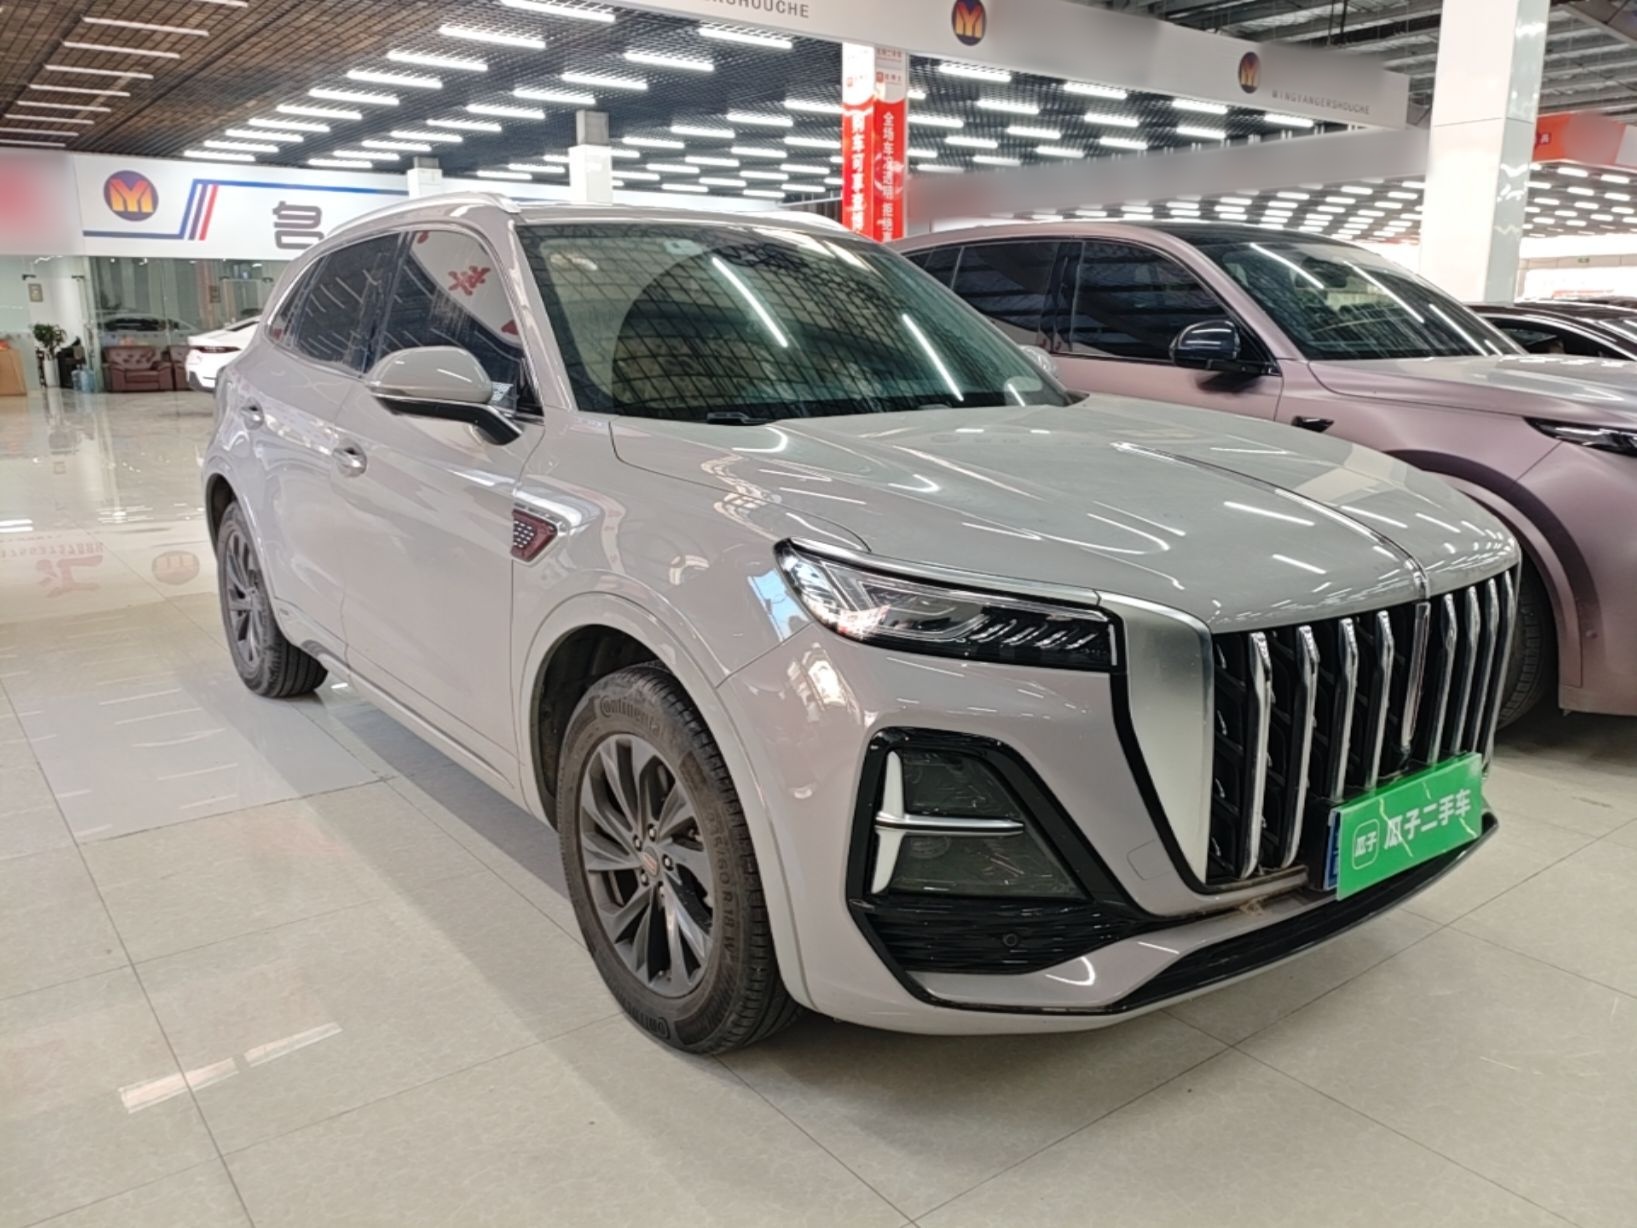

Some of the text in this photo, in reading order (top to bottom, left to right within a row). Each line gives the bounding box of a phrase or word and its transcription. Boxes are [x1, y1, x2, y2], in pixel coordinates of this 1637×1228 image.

[1384, 788, 1472, 850] 瓜子二手车
[1354, 831, 1378, 858] 瓜子
